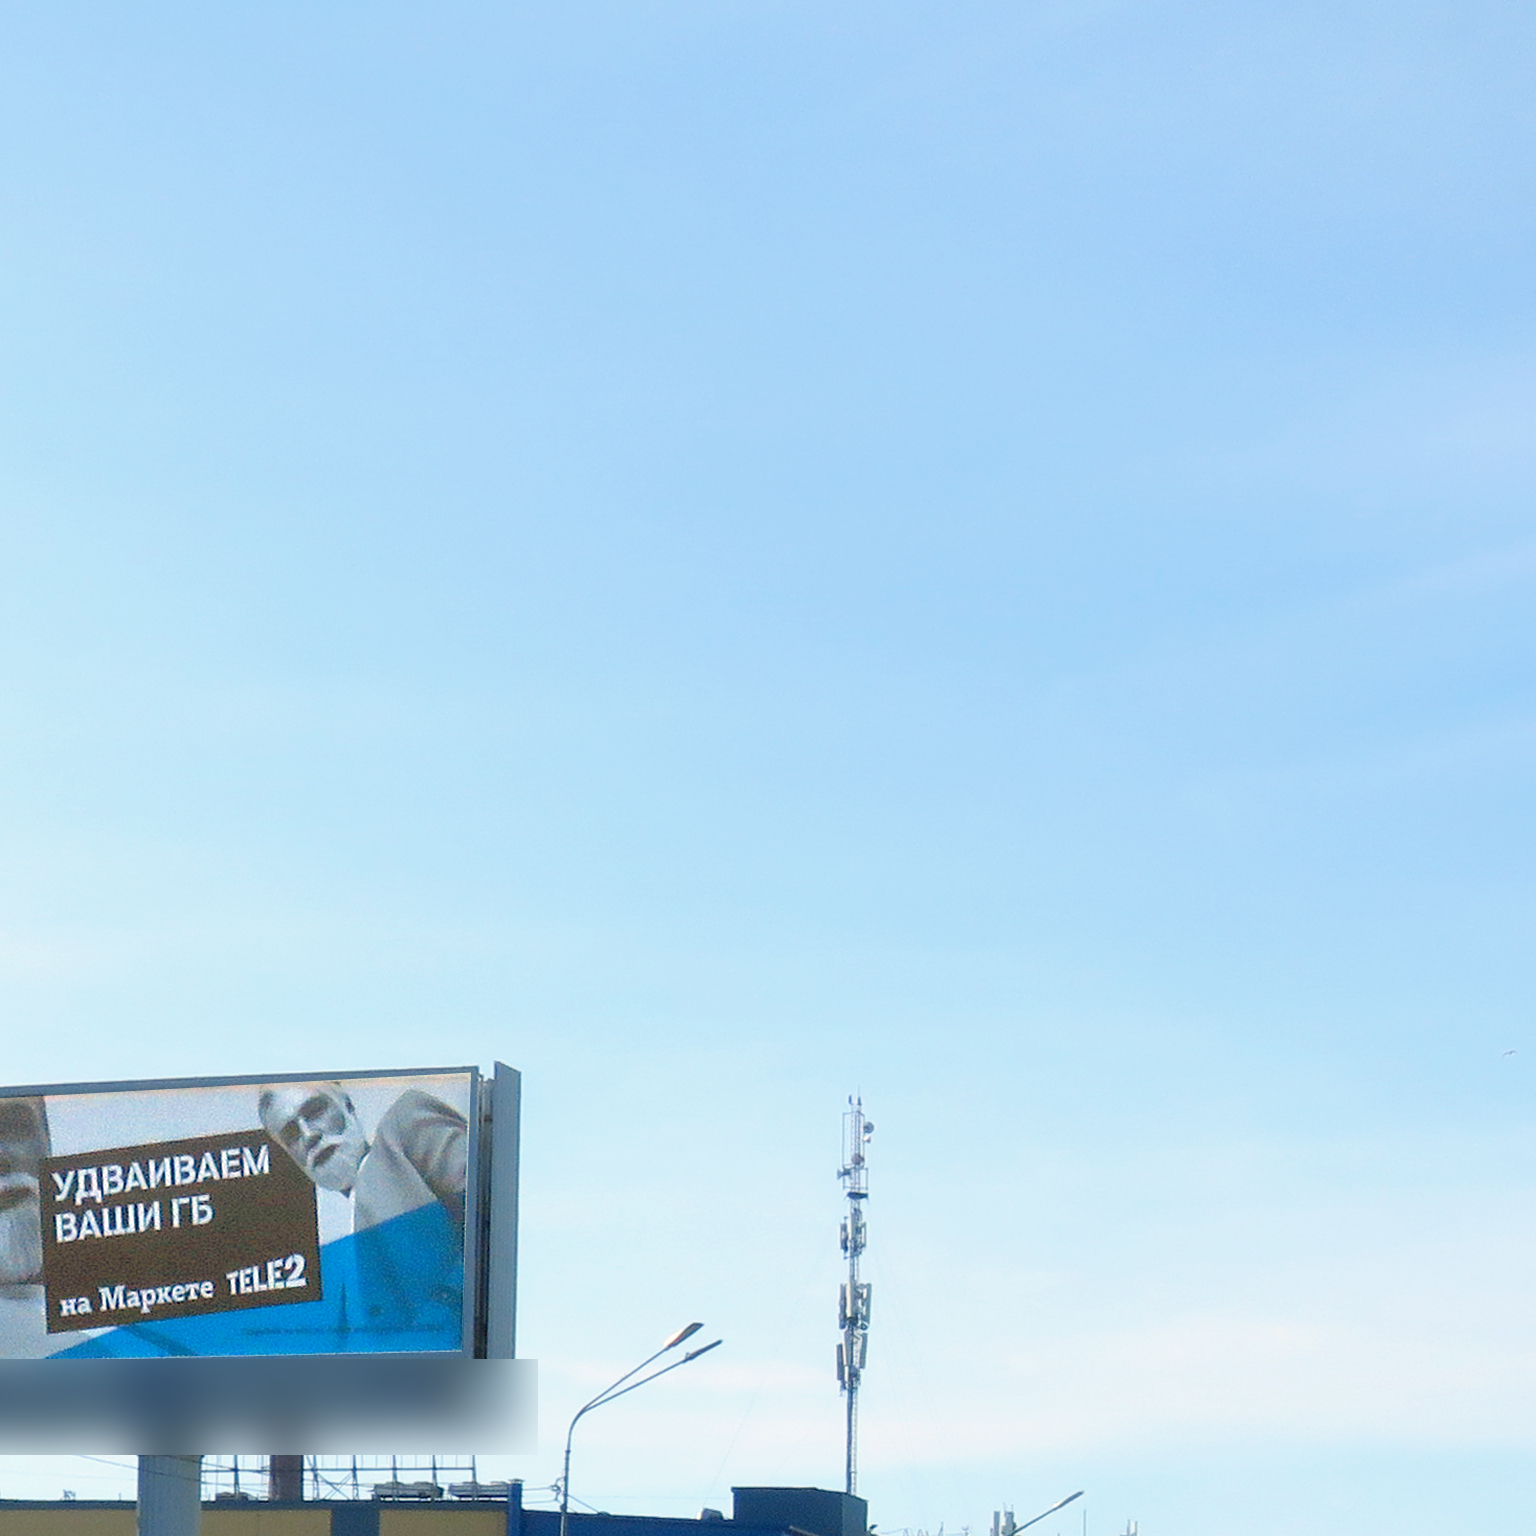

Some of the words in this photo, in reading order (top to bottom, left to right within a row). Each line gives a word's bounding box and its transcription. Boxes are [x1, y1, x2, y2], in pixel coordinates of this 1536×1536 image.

[51, 1145, 271, 1205] УДВАИВАЕМ
[54, 1207, 162, 1243] ВАШИ
[172, 1194, 214, 1229] ГБ
[59, 1291, 92, 1317] на
[99, 1277, 214, 1313] Маркете
[227, 1254, 308, 1296] TELE2
